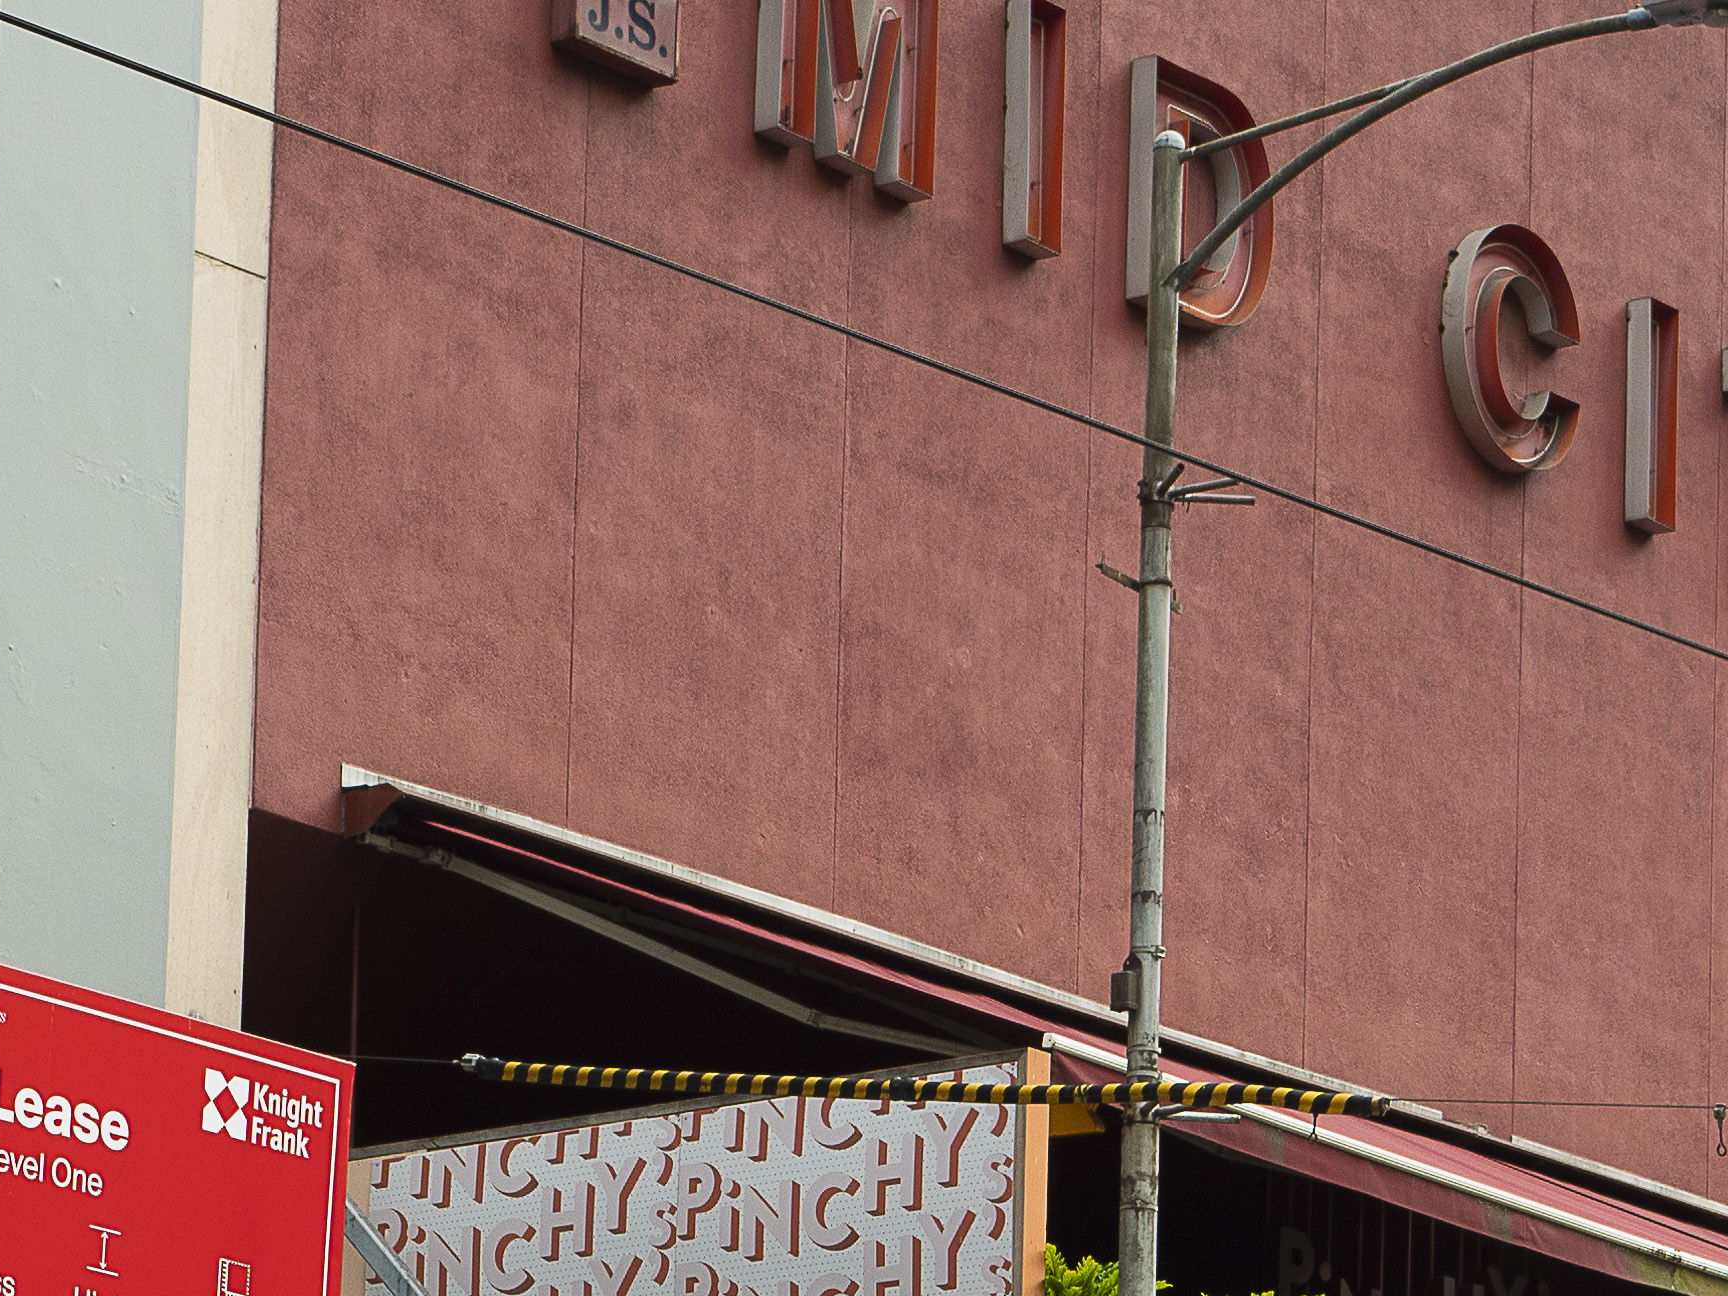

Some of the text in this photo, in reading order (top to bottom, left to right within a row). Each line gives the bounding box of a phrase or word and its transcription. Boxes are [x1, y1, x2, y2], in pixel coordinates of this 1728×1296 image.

[754, 0, 1273, 332] MID
[253, 1081, 324, 1129] Knight
[251, 1115, 310, 1159] Frank
[51, 1157, 103, 1197] One
